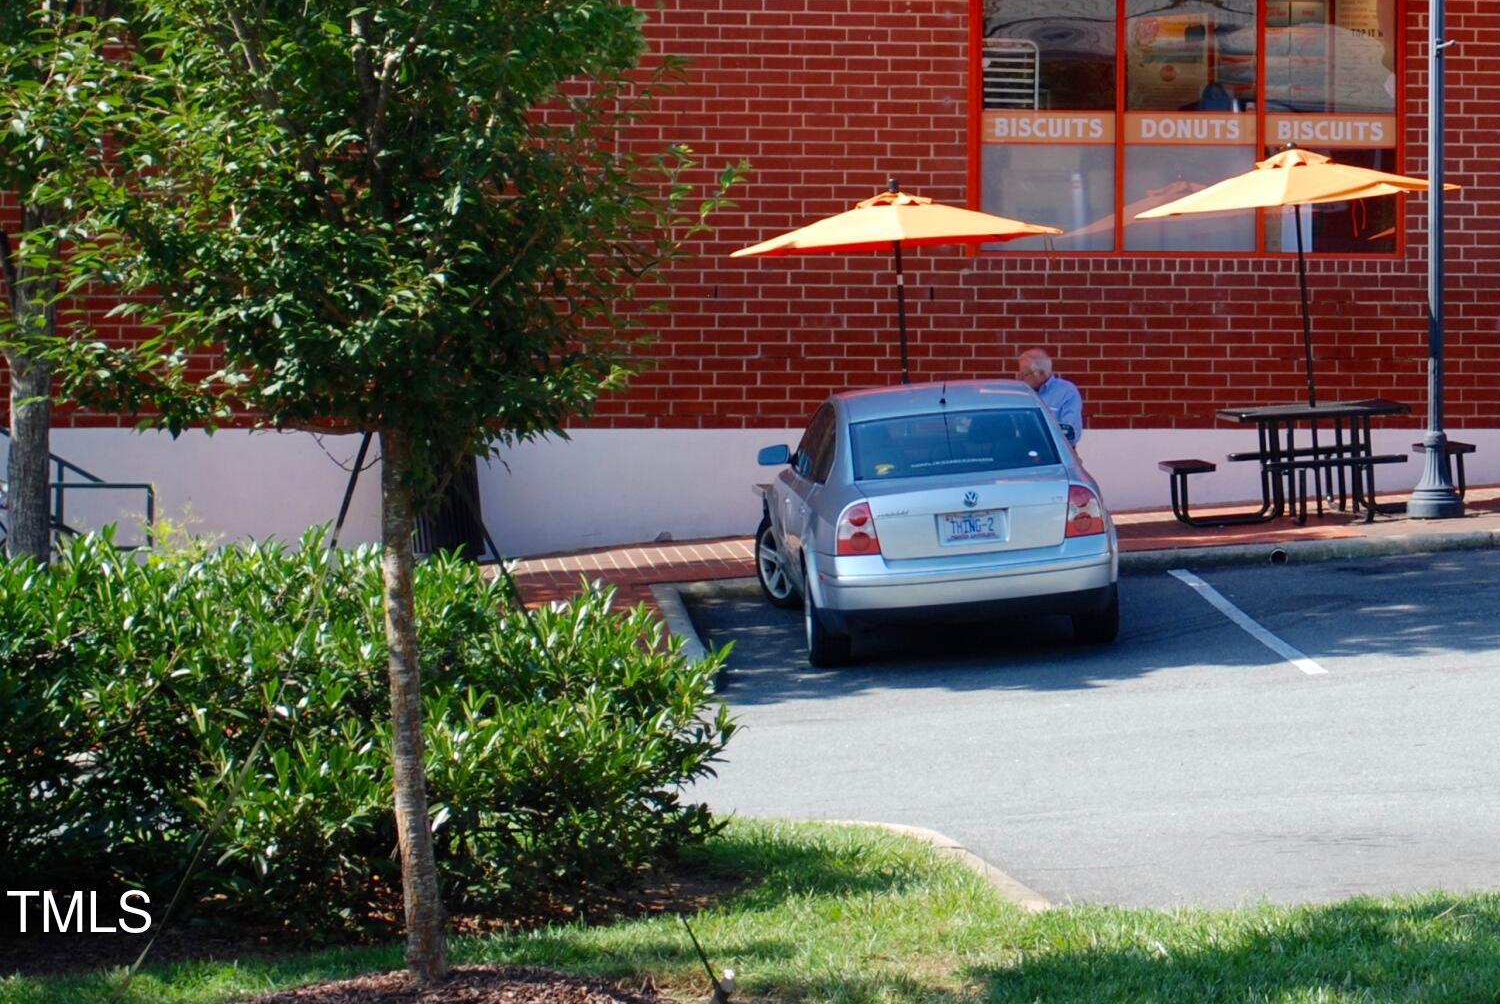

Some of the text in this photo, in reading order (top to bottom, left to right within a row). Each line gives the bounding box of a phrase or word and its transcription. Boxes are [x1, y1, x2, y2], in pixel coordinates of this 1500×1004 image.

[994, 117, 1104, 139] BISCUITS
[1140, 118, 1240, 140] DONUTS
[1277, 120, 1384, 141] BISCUITS
[950, 516, 994, 534] THING-2
